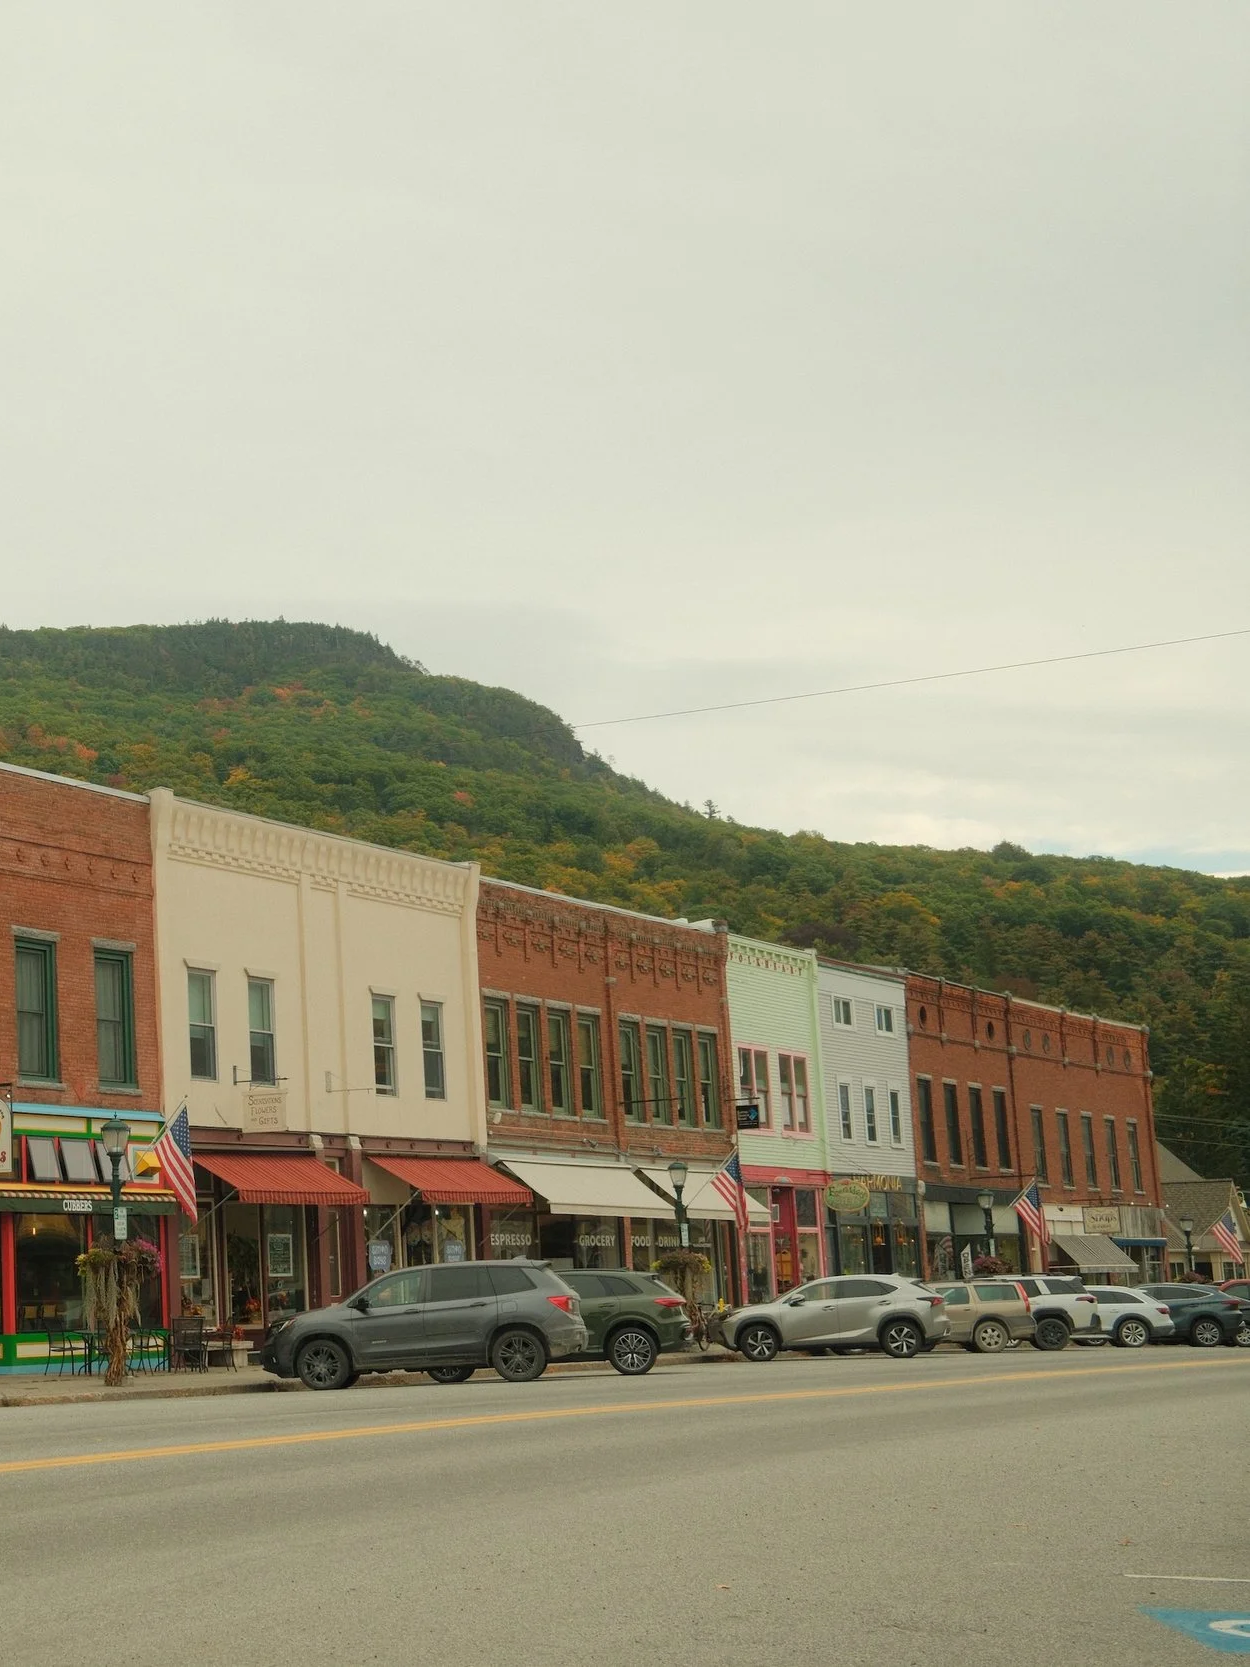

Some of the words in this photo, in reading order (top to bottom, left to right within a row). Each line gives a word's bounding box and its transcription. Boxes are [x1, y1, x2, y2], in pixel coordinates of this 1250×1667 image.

[258, 1116, 278, 1125] GIFTS
[62, 1199, 93, 1212] CUBBERS
[490, 1233, 532, 1246] ESPRESSO
[578, 1235, 616, 1247] GROCERY
[631, 1235, 651, 1247] FOOD
